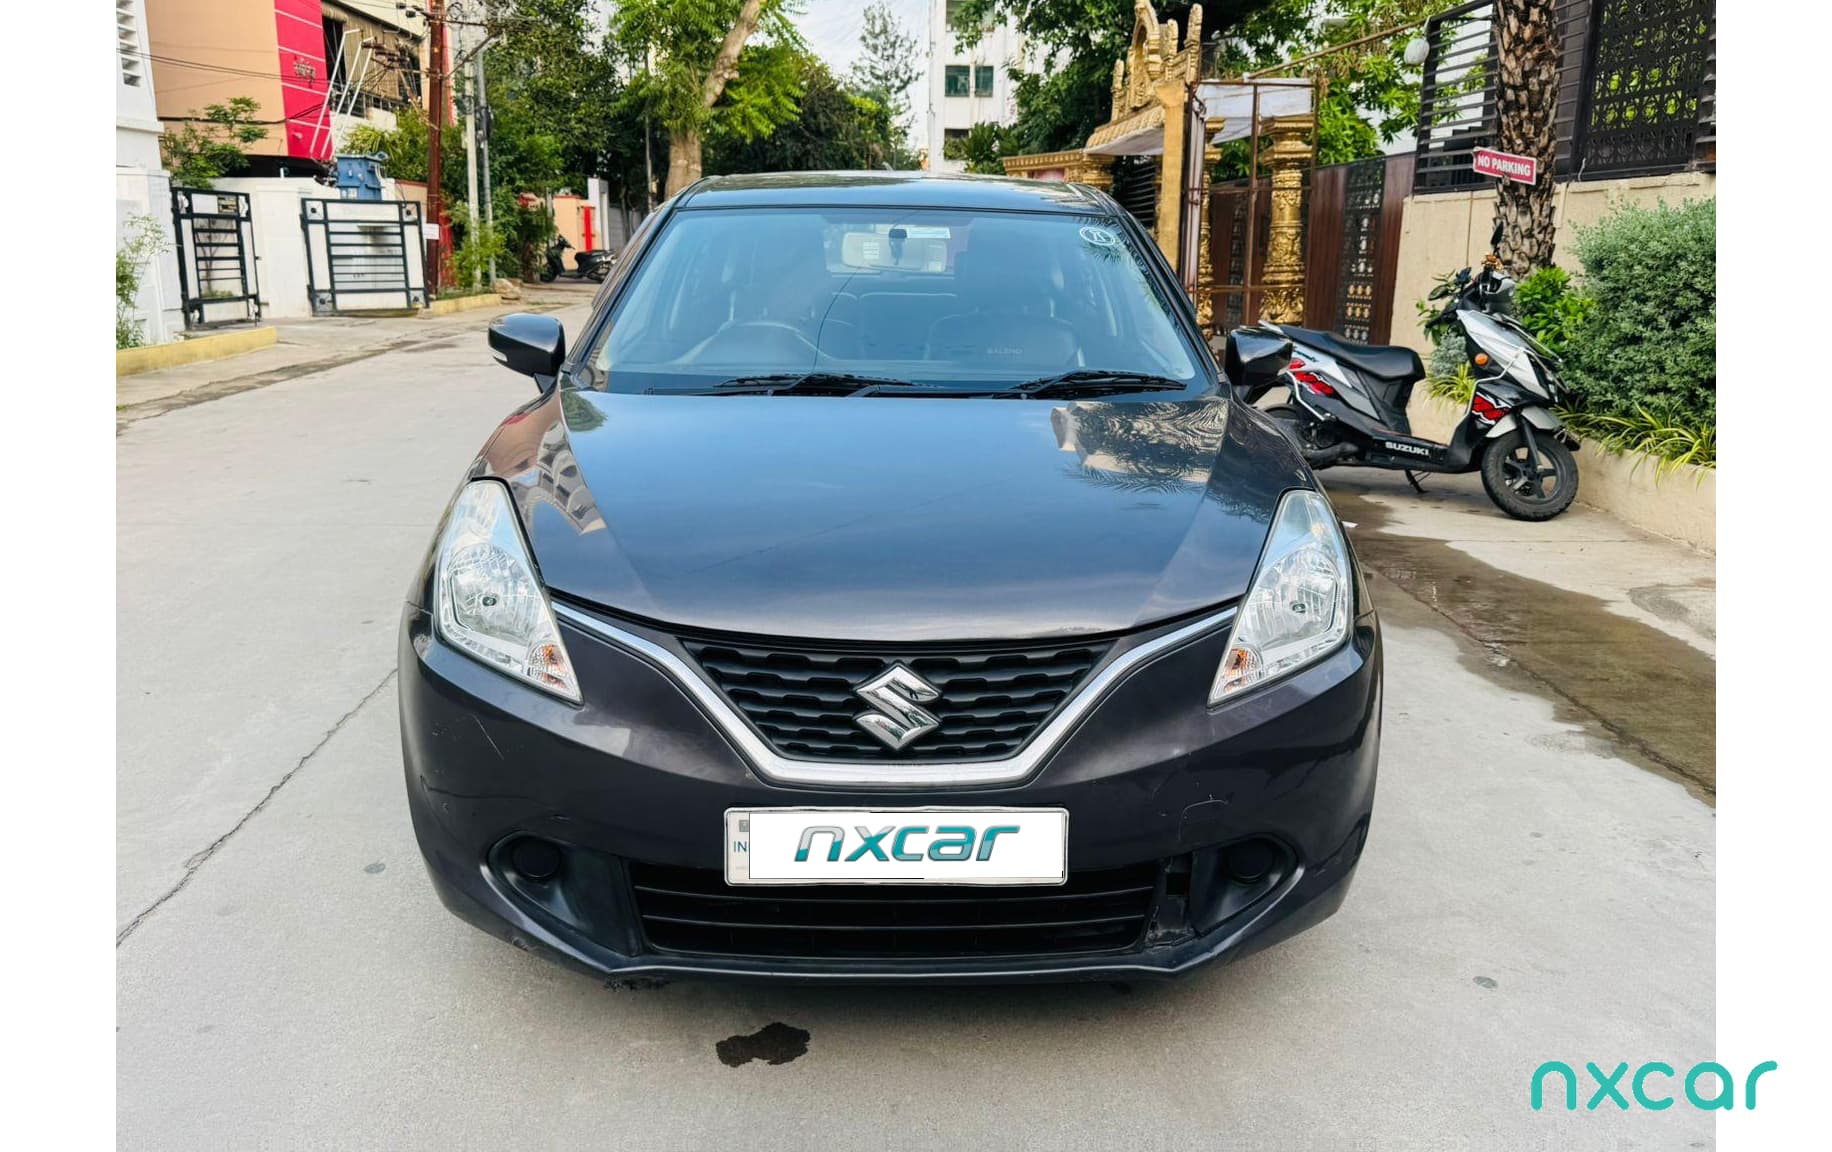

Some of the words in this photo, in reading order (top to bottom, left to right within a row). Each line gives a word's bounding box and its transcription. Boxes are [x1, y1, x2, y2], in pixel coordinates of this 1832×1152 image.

[1477, 155, 1491, 168] NO
[1492, 158, 1531, 177] PARKING
[1385, 441, 1429, 456] SUZUKI
